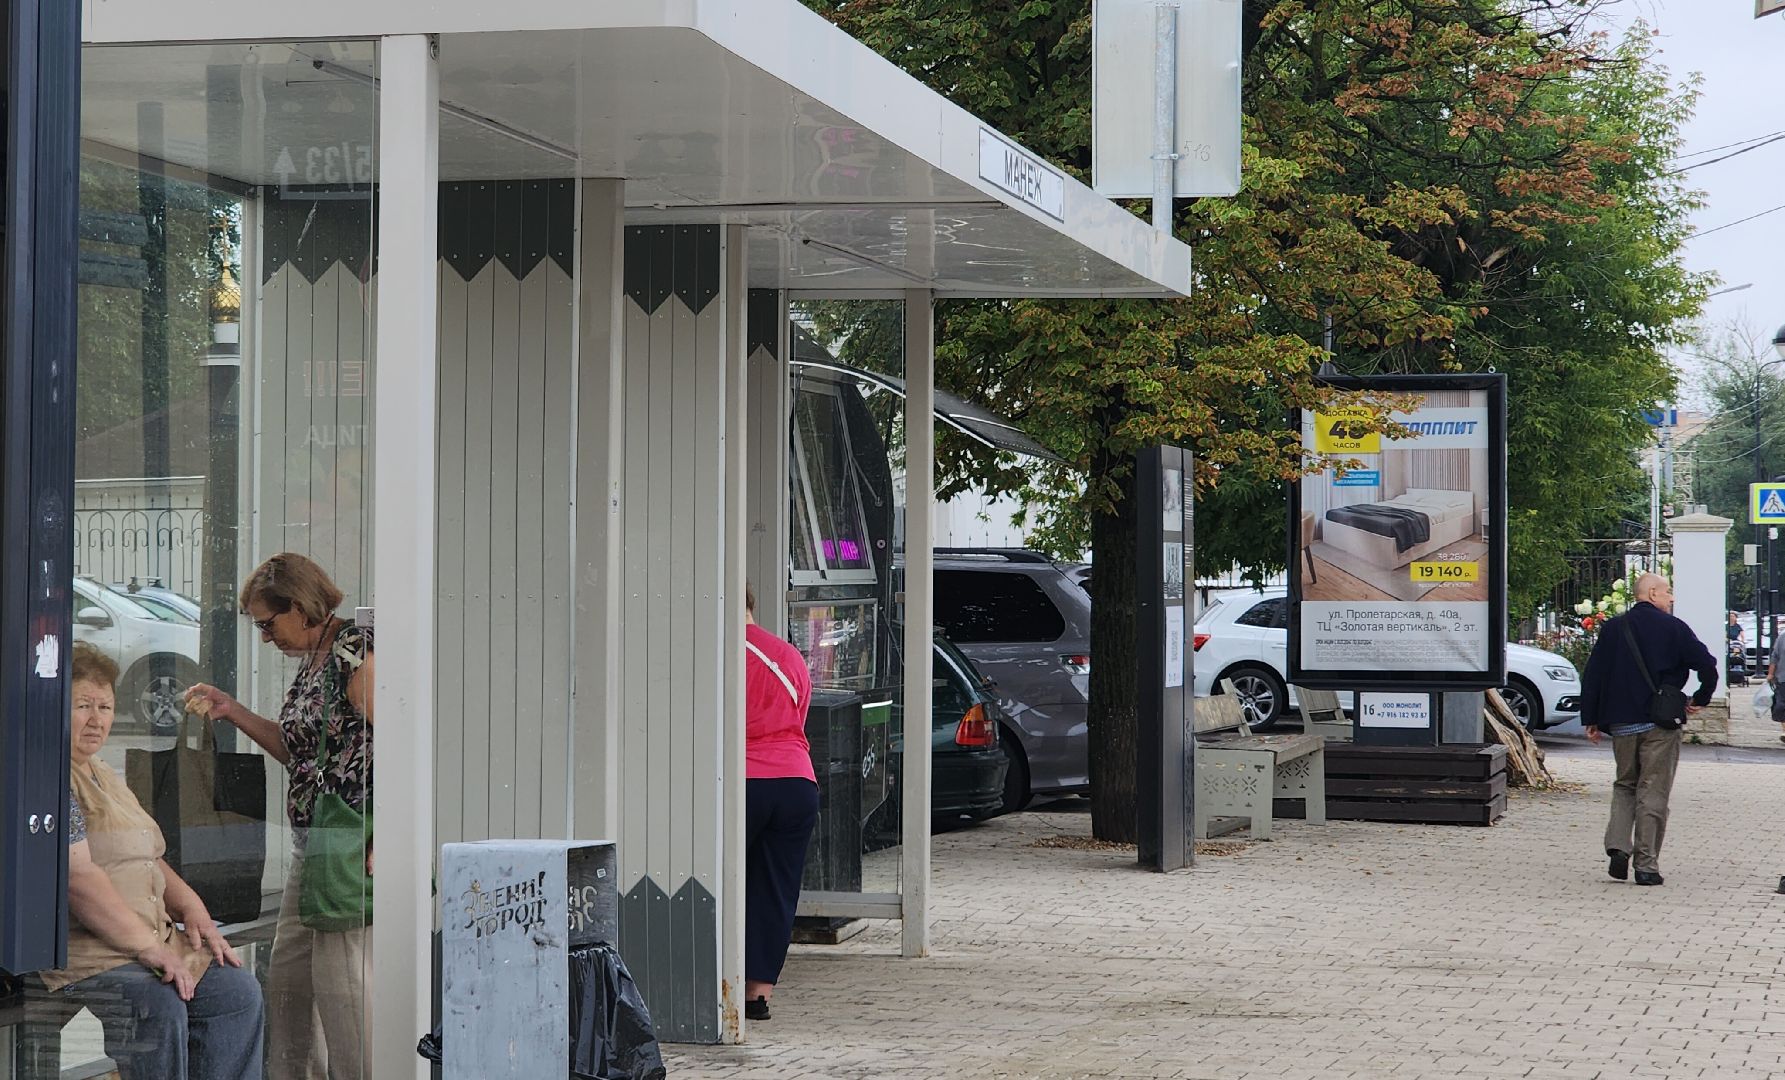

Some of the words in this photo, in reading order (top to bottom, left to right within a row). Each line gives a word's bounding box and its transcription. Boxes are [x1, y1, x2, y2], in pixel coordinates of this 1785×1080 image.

[1004, 149, 1043, 204] МАНЕЖ
[1419, 566, 1434, 577] 19
[1438, 566, 1463, 577] 140
[1328, 611, 1344, 621] ул.
[1346, 609, 1424, 621] Пролетарская,
[1439, 609, 1462, 621] 40а,
[1316, 621, 1332, 633] ТЦ
[1334, 621, 1384, 632] «Золотая
[1454, 622, 1461, 632] 2
[1463, 624, 1478, 632] эт.
[1363, 703, 1375, 716] 16
[475, 899, 548, 938] ГОРОД
